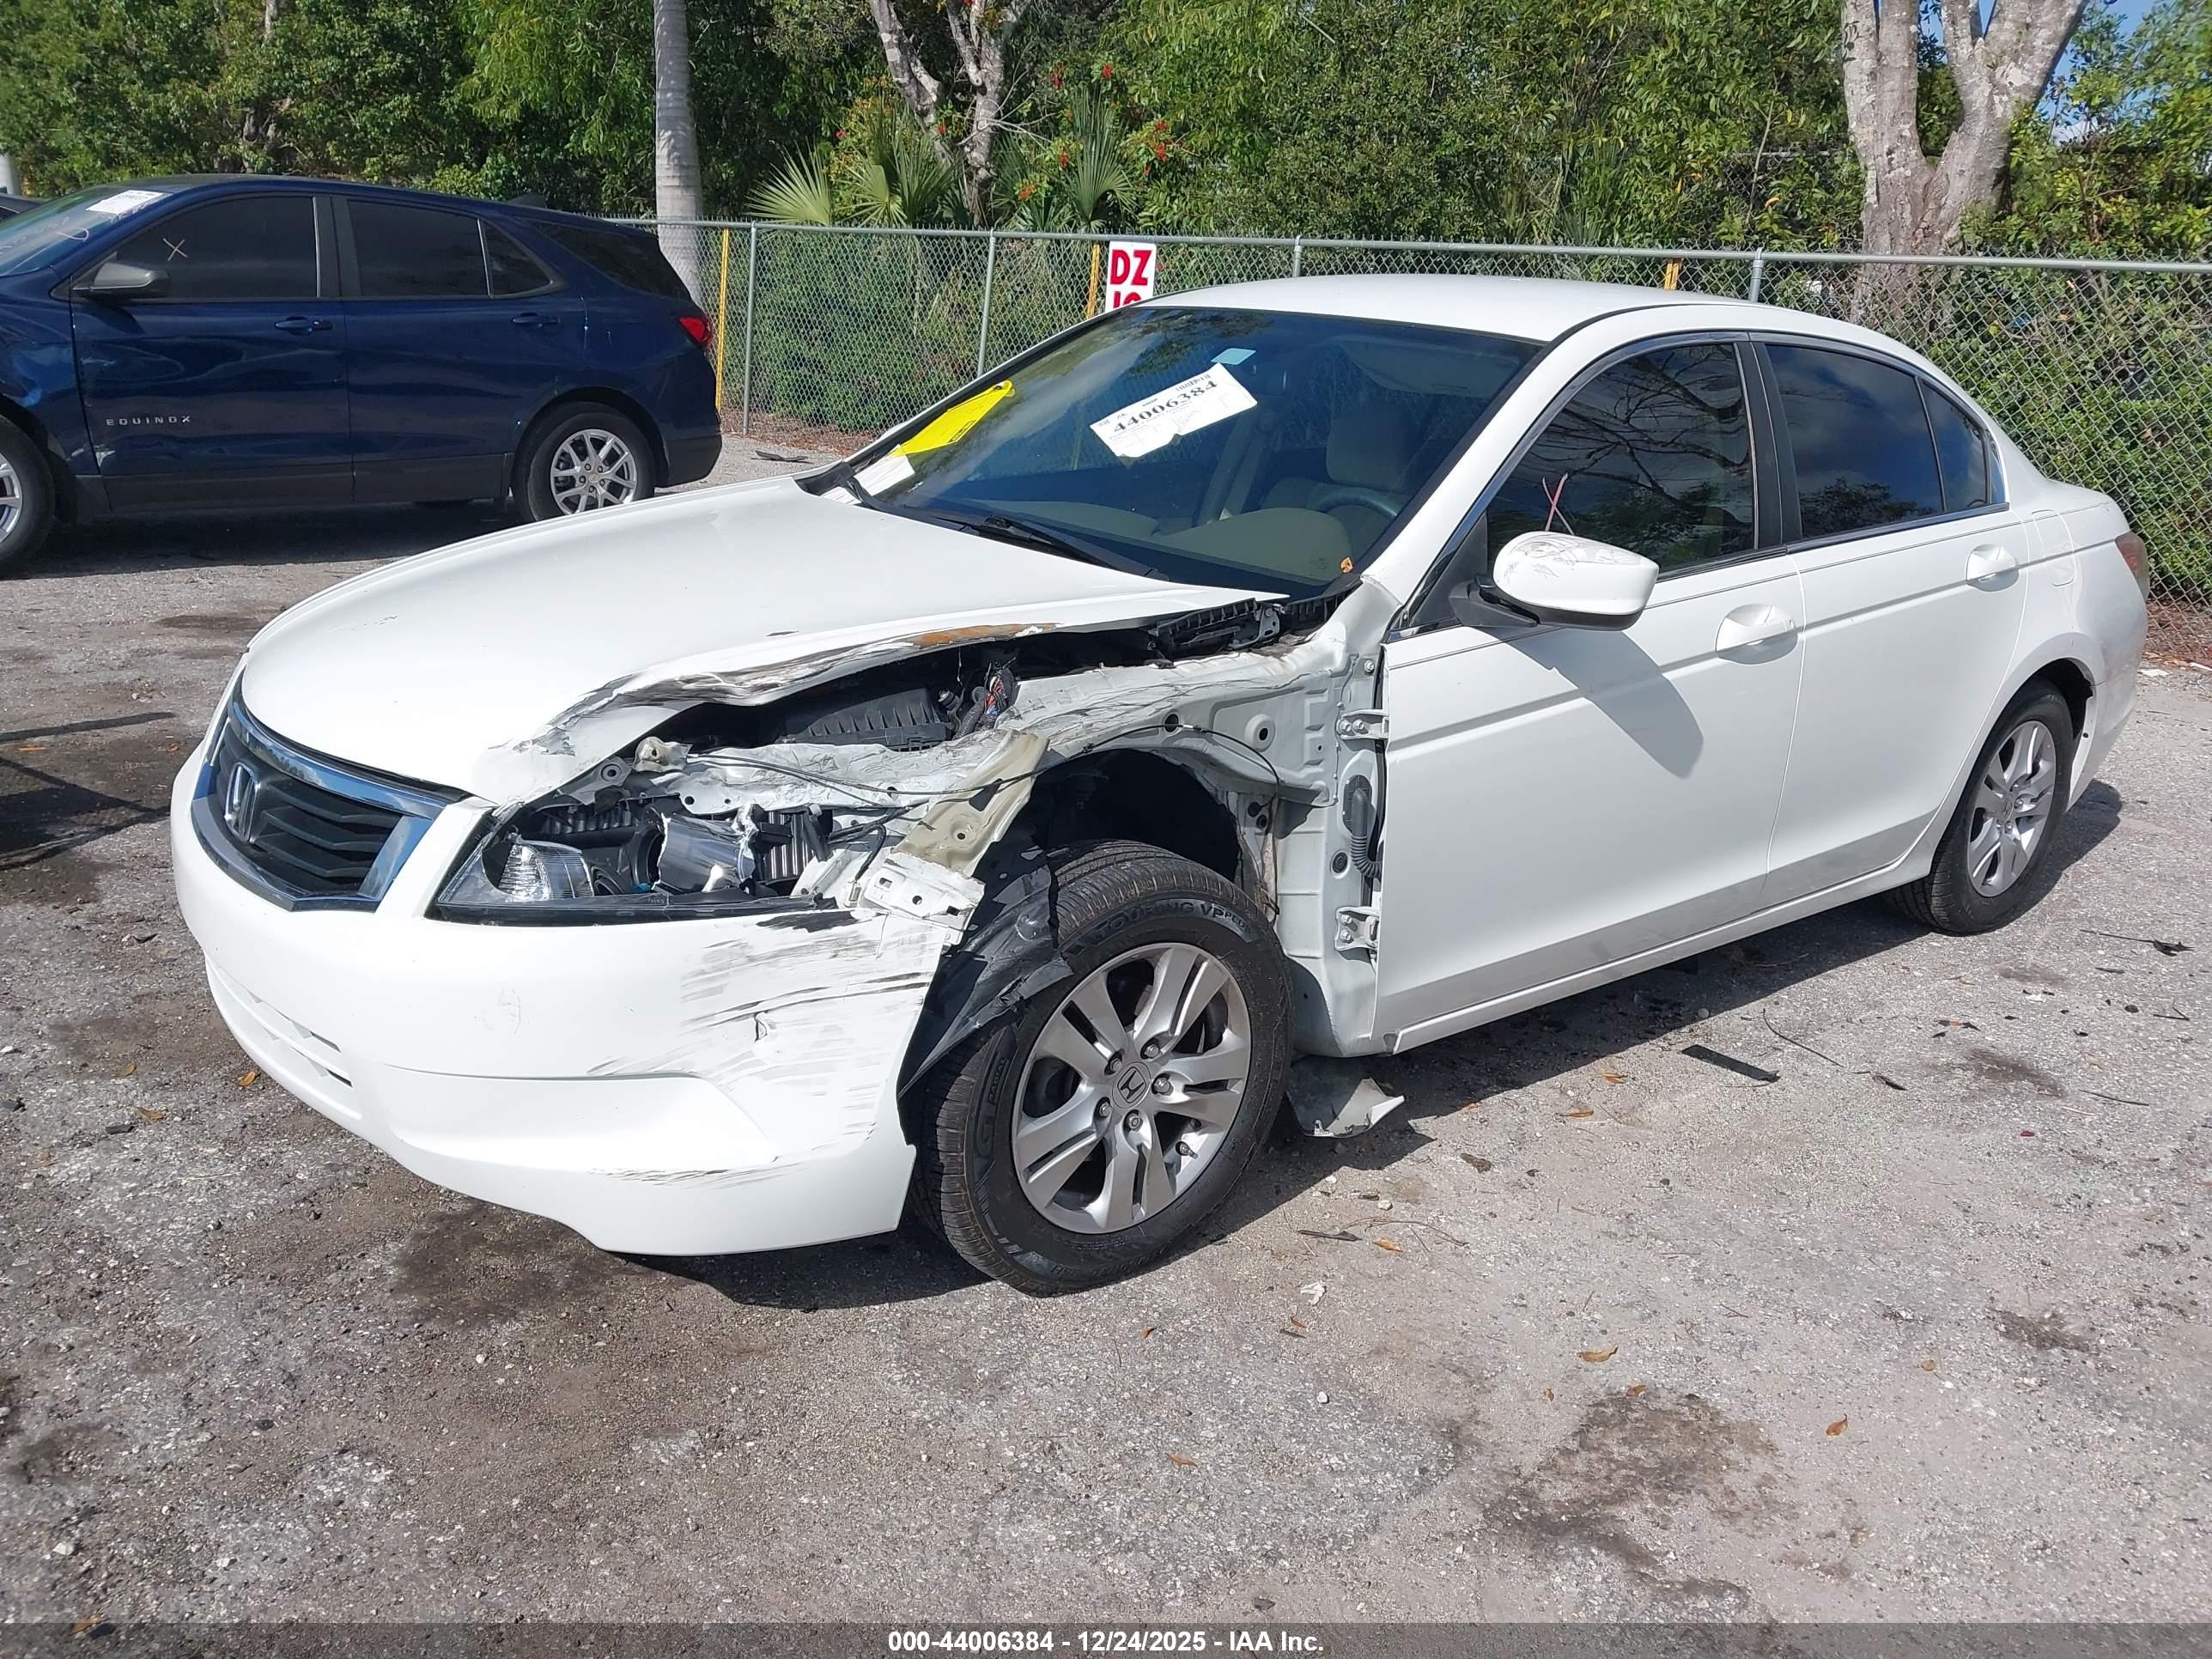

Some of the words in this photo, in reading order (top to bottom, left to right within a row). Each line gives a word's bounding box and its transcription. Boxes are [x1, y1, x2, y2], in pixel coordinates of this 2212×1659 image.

[1110, 249, 1152, 286] DZ
[106, 415, 191, 426] EQUINOX
[1113, 380, 1218, 433] 44006384
